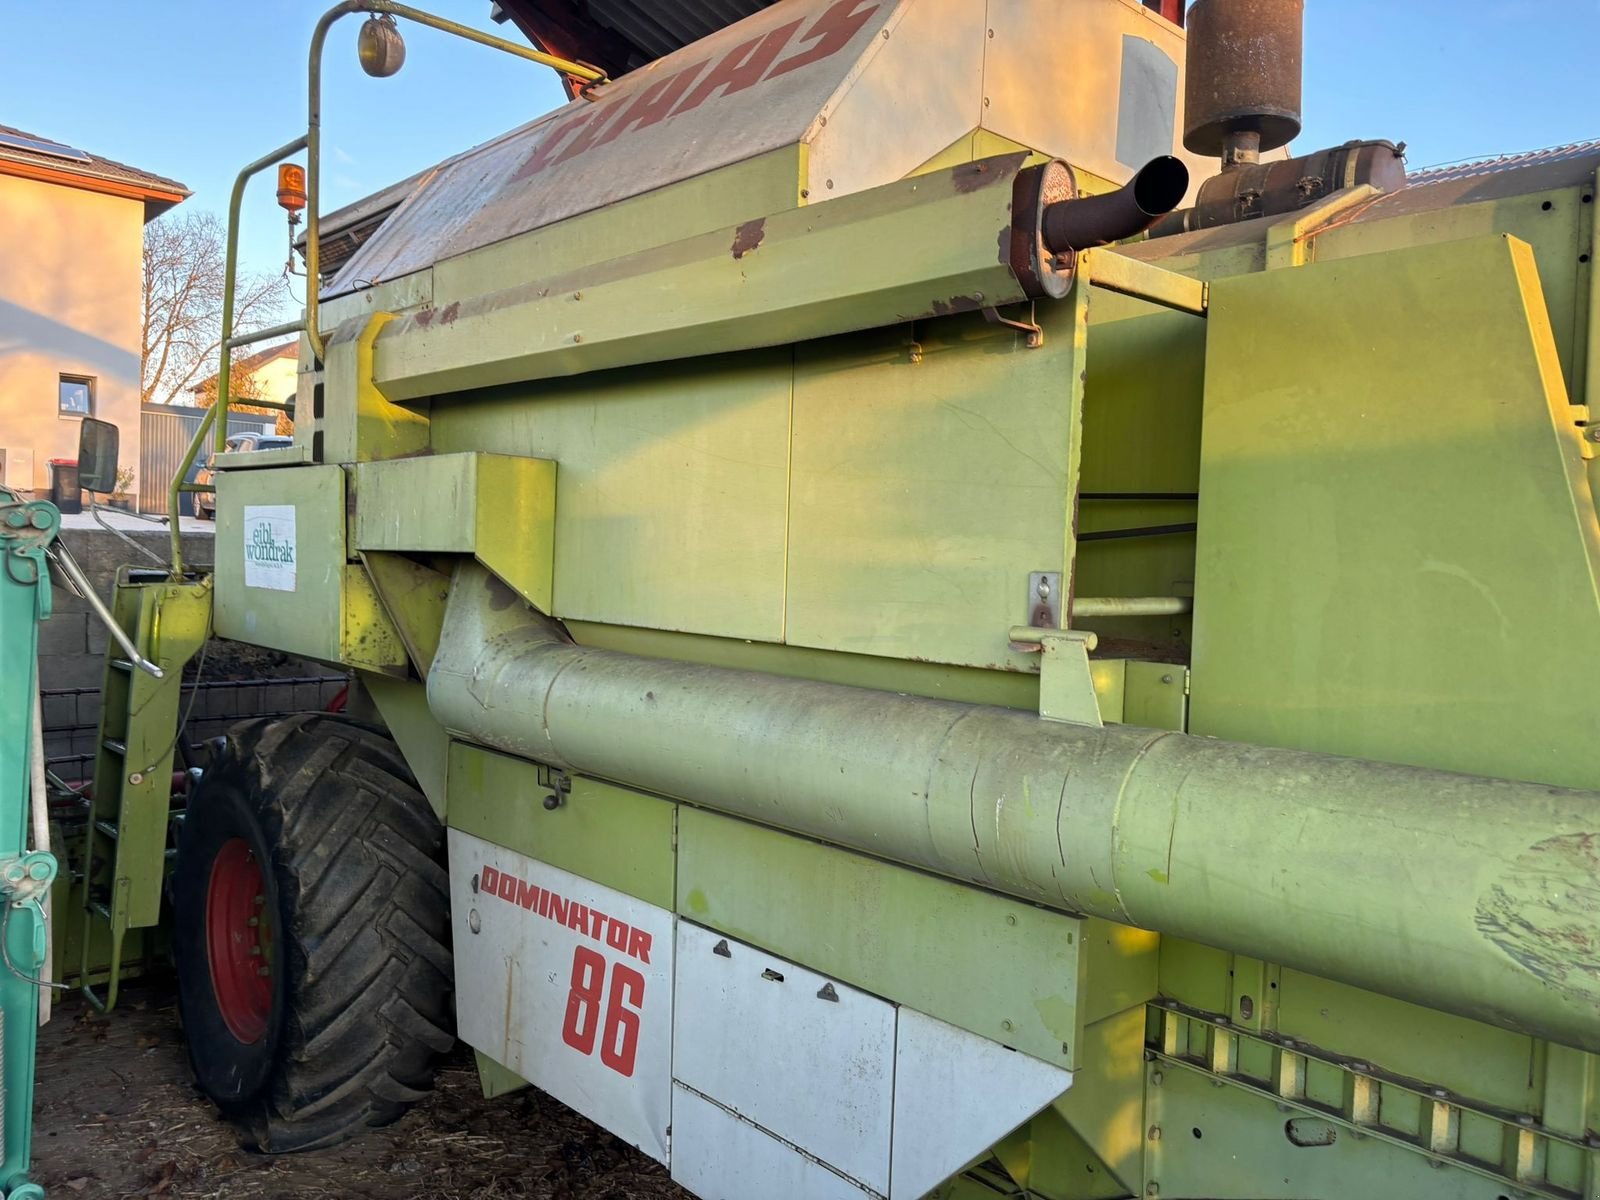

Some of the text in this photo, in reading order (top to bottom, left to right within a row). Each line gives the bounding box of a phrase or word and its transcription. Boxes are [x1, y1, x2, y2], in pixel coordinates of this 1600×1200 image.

[512, 0, 881, 182] CLAAS
[246, 540, 293, 563] wondrak
[481, 865, 652, 965] DOMINATOR
[562, 945, 645, 1078] 86
